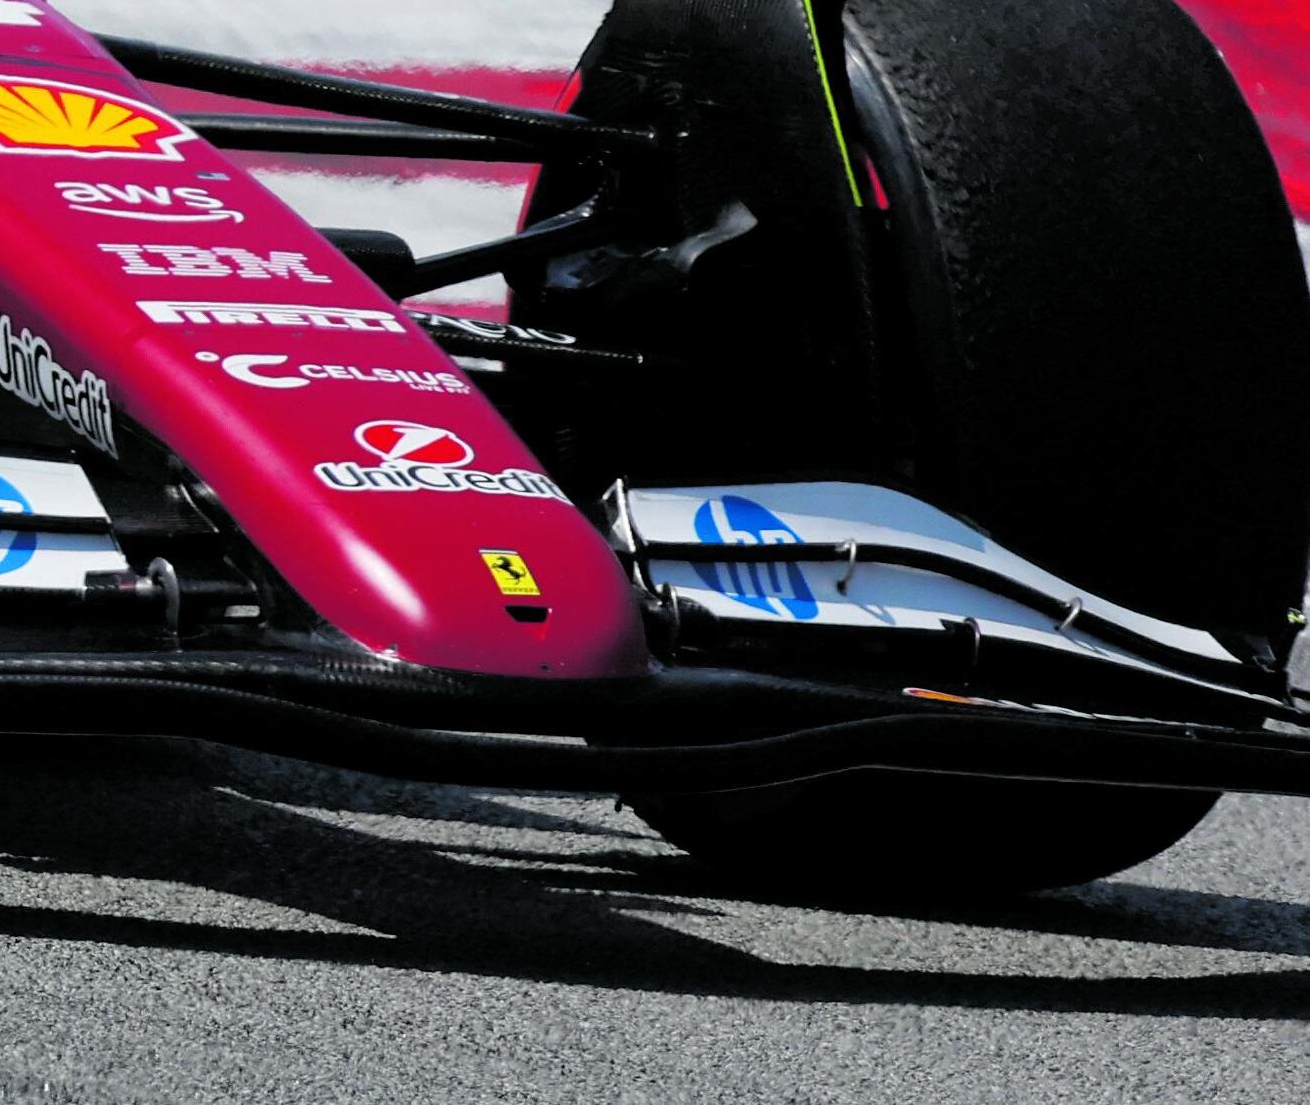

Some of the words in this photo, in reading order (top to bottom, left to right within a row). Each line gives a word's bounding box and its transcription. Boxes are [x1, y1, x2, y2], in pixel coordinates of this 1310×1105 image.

[54, 181, 225, 210] aws
[97, 242, 333, 283] IBM
[134, 300, 408, 334] PIRELLI
[299, 363, 466, 389] CELSIUS
[317, 463, 572, 502] UniCredit
